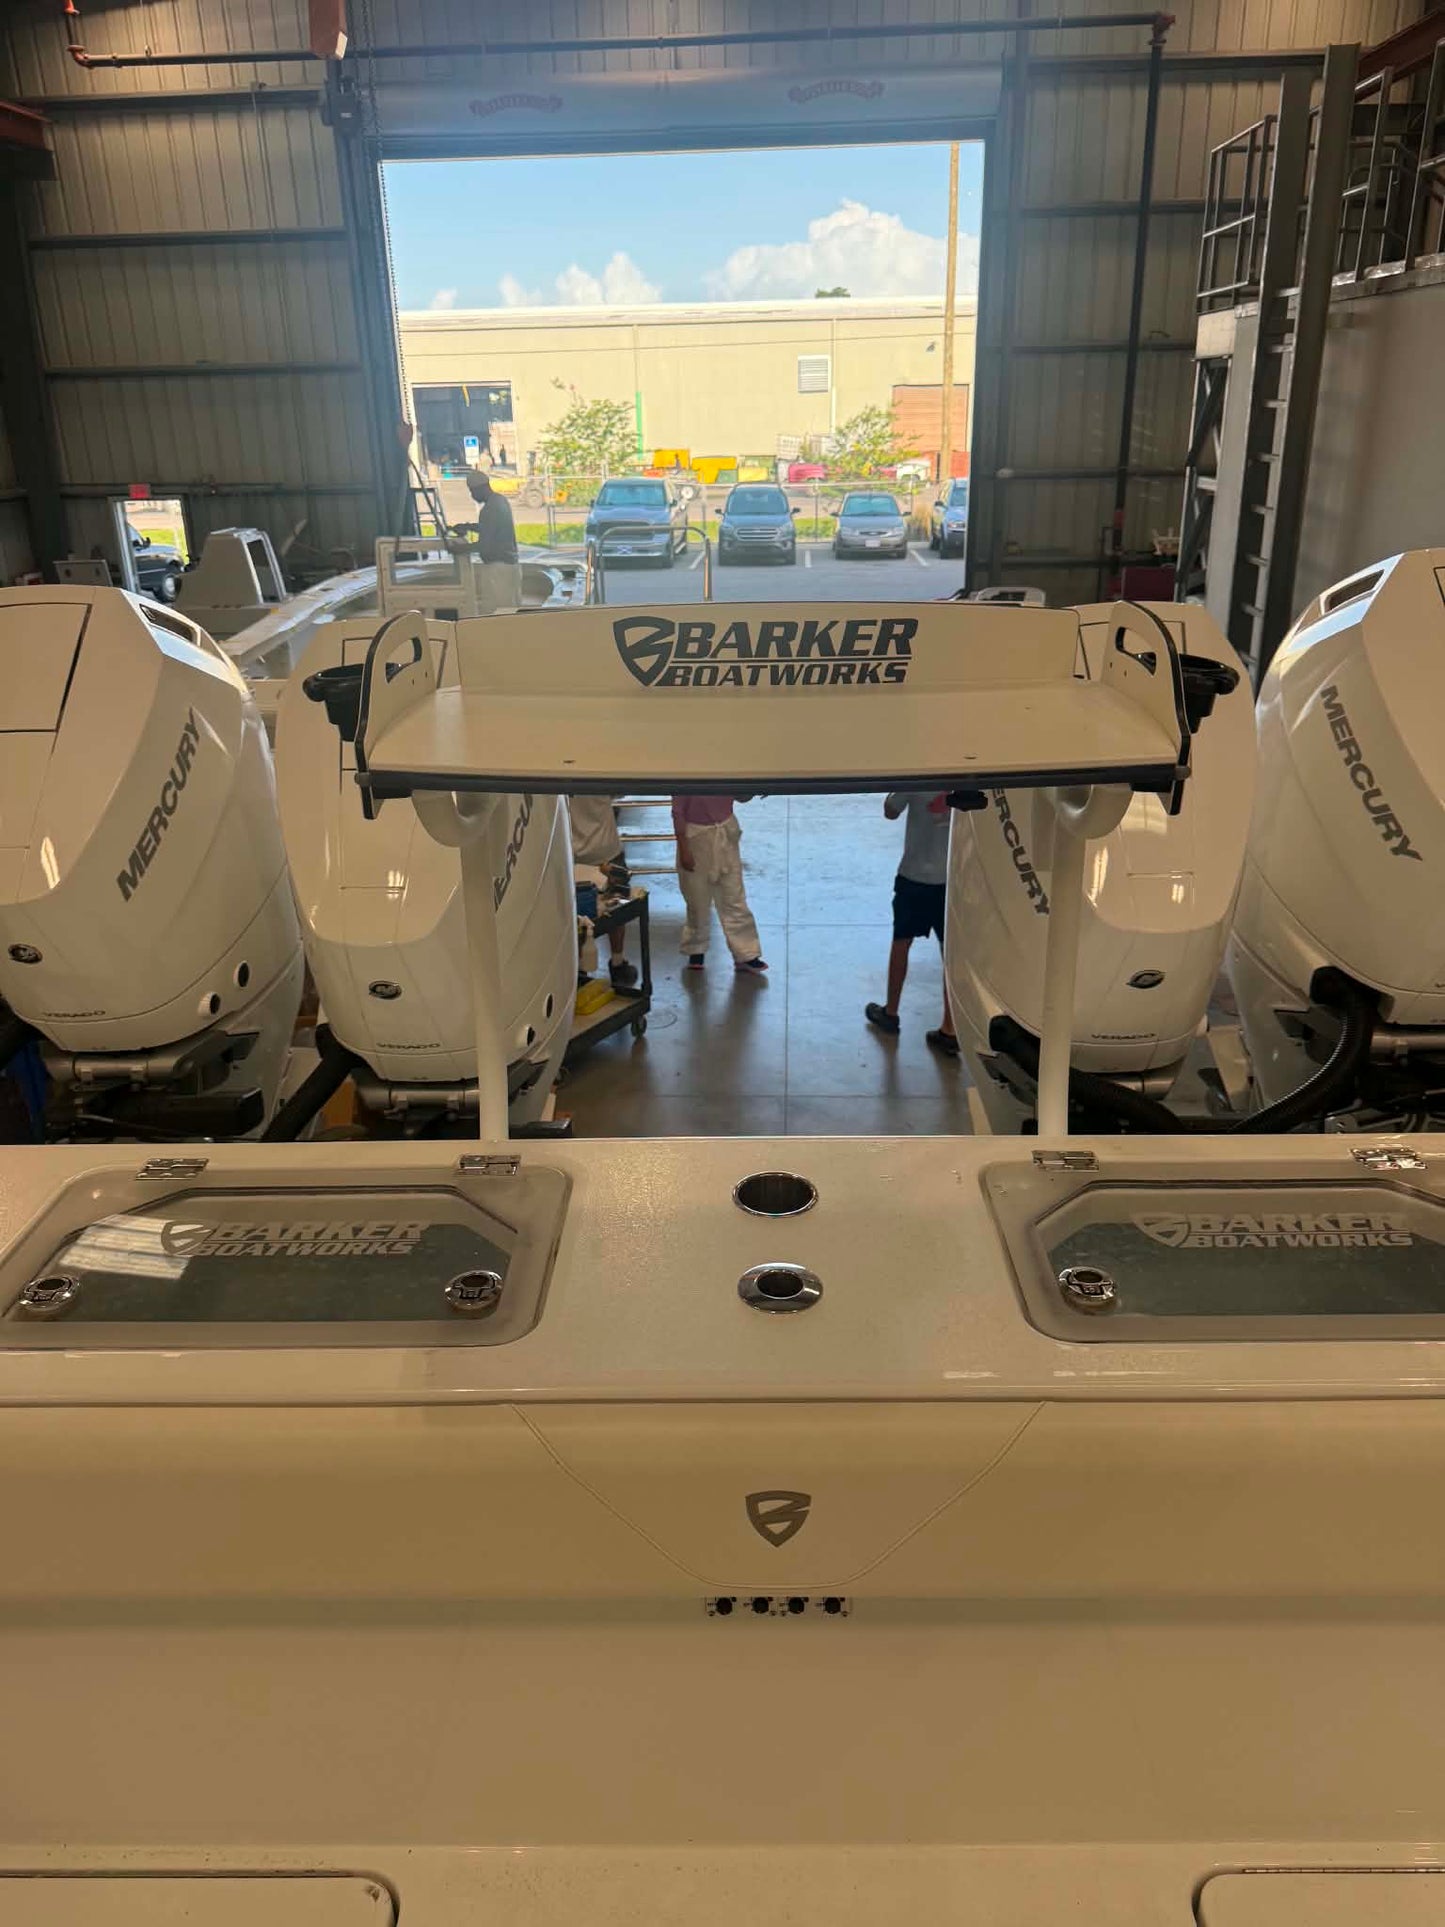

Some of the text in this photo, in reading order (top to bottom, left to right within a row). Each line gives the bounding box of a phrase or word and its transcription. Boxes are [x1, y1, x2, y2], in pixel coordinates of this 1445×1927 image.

[671, 618, 919, 659] BARKER
[653, 662, 908, 687] BOATWORKS
[1320, 684, 1423, 861] MERCURY
[115, 704, 200, 902] MERCURY
[204, 1219, 430, 1241] BARKER
[1188, 1212, 1407, 1232] BARKER
[184, 1241, 419, 1256] BOATWORKS
[1179, 1233, 1414, 1248] BOATWORKS
